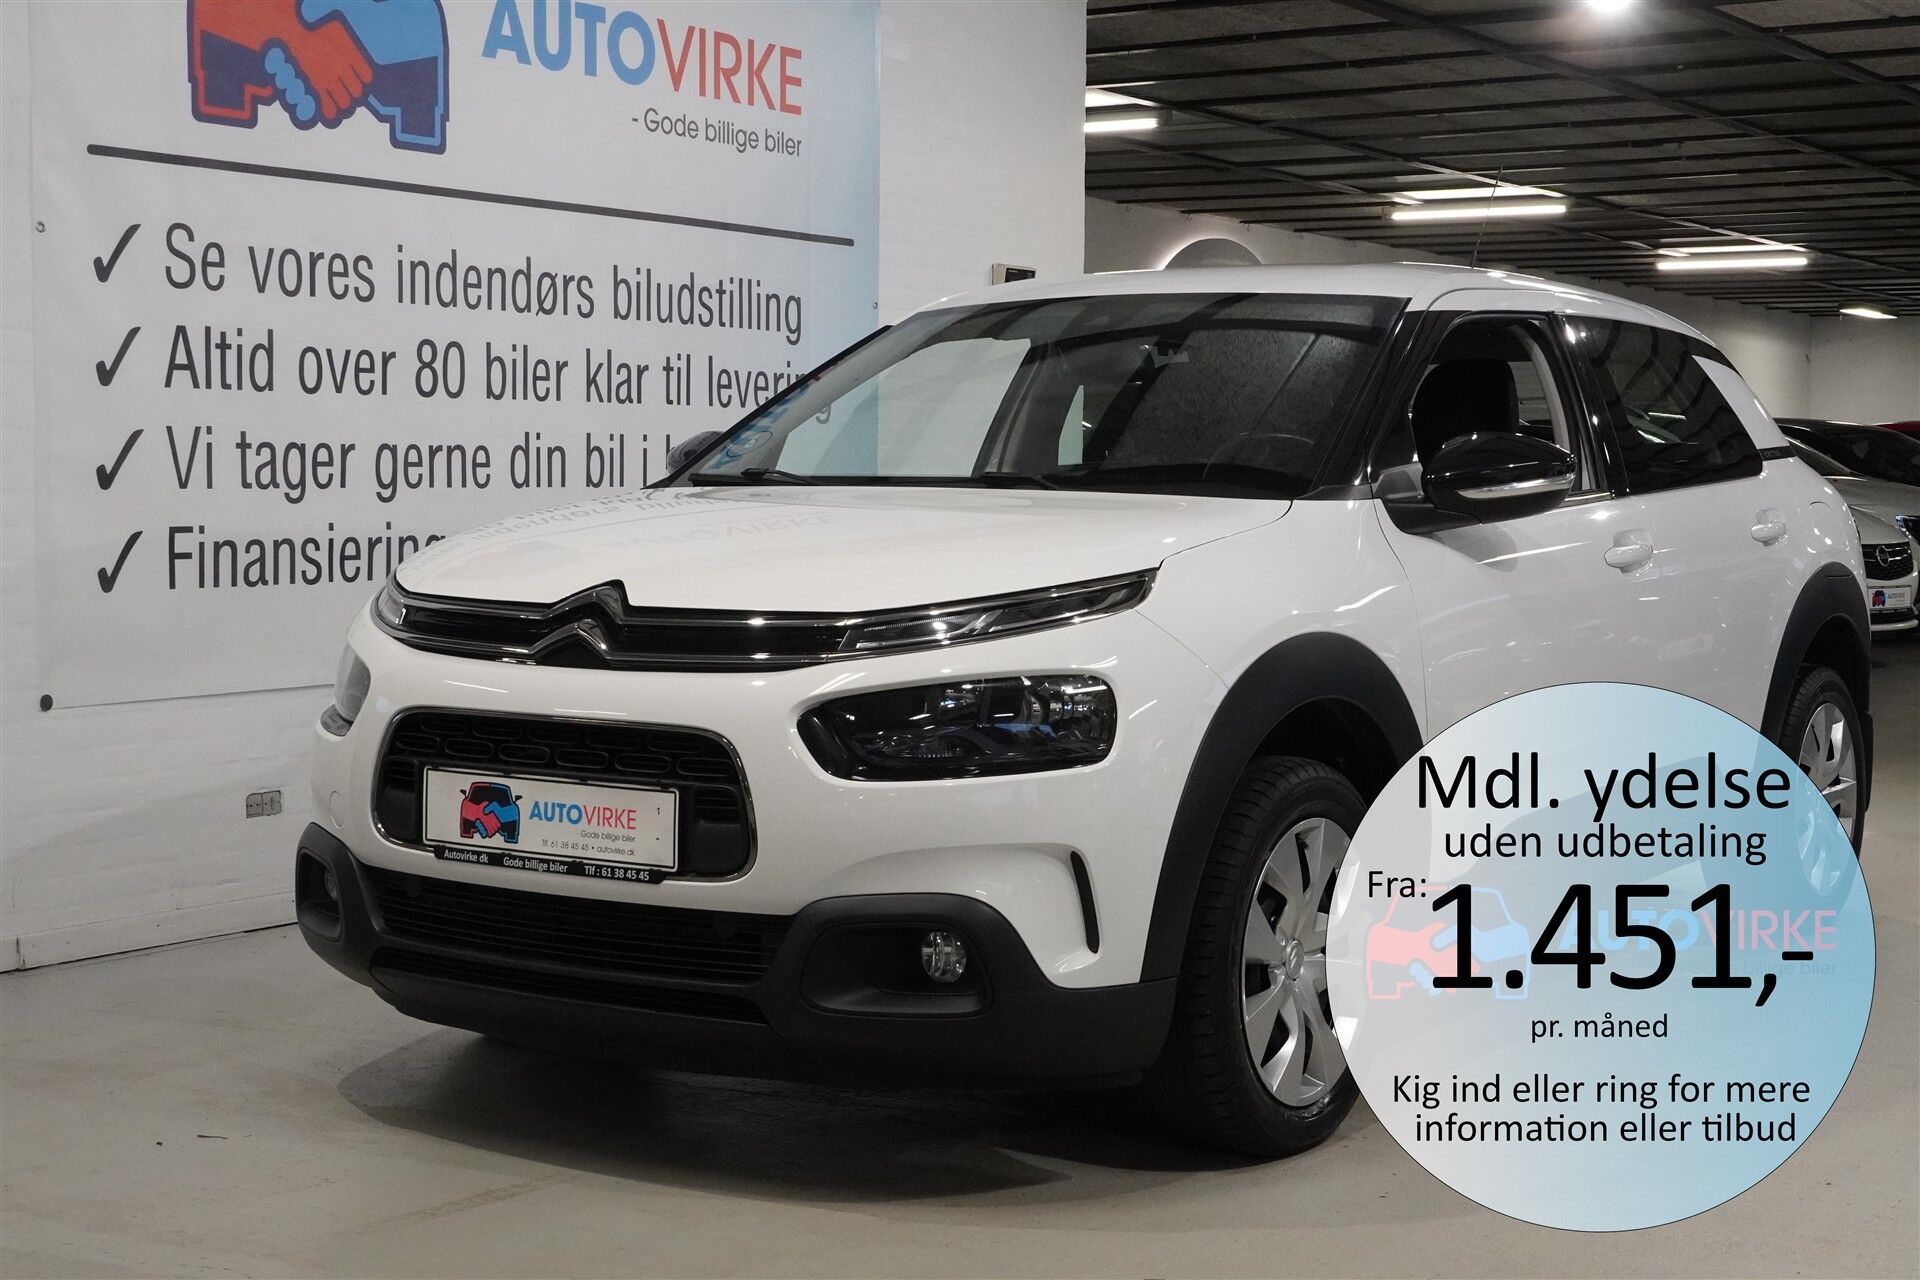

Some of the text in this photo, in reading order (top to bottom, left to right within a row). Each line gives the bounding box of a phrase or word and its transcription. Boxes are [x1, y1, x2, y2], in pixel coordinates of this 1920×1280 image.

[481, 0, 802, 116] AUTOVIRKE
[643, 107, 699, 139] Gode
[704, 118, 759, 154] billige
[764, 129, 802, 157] biler
[165, 222, 802, 345] Se vores indendørs biludstilling
[163, 324, 274, 393] Altid
[298, 347, 397, 396] over
[414, 338, 466, 400] 80
[485, 341, 569, 402] biler
[585, 347, 649, 405] klar
[662, 352, 691, 406] til
[165, 425, 213, 490] Vi
[235, 430, 356, 504] tager
[374, 442, 491, 504] gerne
[510, 431, 567, 490] din
[585, 432, 625, 489] bil
[642, 433, 649, 488] i
[166, 521, 446, 591] Finansierin
[528, 801, 637, 830] AUTOVIRKE
[443, 849, 478, 862] Autovirke
[550, 840, 559, 848] 61
[560, 841, 569, 850] 38
[571, 842, 579, 851] 45
[580, 843, 590, 852] 45
[580, 830, 636, 843] Gode billige biler
[503, 857, 568, 873] Gode billige biler
[601, 867, 612, 877] 61
[613, 868, 625, 878] 38
[626, 870, 637, 880] 45
[638, 871, 650, 881] 45
